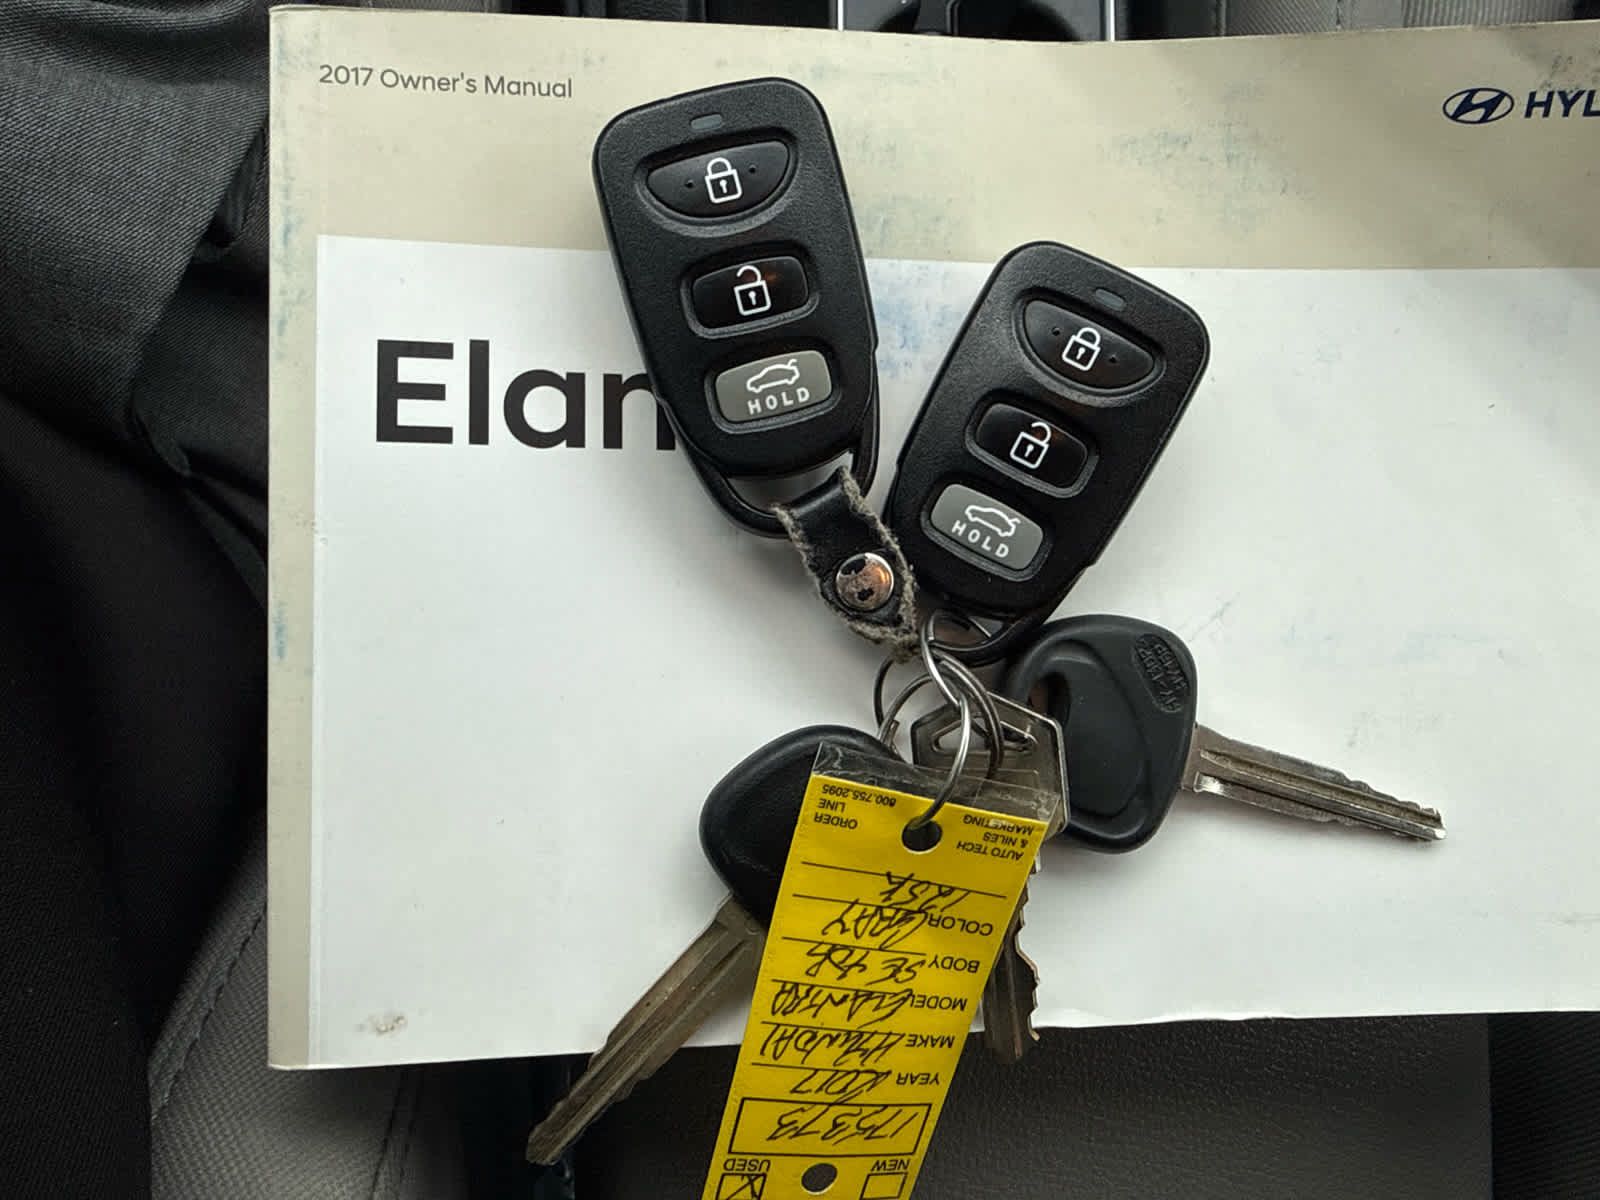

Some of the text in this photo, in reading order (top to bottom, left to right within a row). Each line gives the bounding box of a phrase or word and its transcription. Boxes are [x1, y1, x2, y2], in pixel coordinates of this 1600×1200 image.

[318, 63, 573, 99] 2017 Owner's Manual
[747, 386, 810, 416] HOLD
[951, 519, 1010, 559] HOLD
[818, 797, 846, 814] LINE
[813, 812, 859, 831] ORDER
[962, 814, 1035, 836] MARKETING
[982, 831, 1018, 848] NILES
[955, 841, 1025, 861] AUTO TECH
[821, 898, 930, 951] GRAY
[928, 914, 994, 937] COLOR
[929, 954, 980, 974] BODY
[909, 994, 969, 1012] MODEL
[759, 1024, 906, 1067] HYUNDAI
[906, 1033, 955, 1049] MAKE
[789, 1068, 893, 1107] 2017
[896, 1071, 941, 1086] YEAR
[723, 1158, 772, 1173] USED
[870, 1159, 911, 1172] NEW
